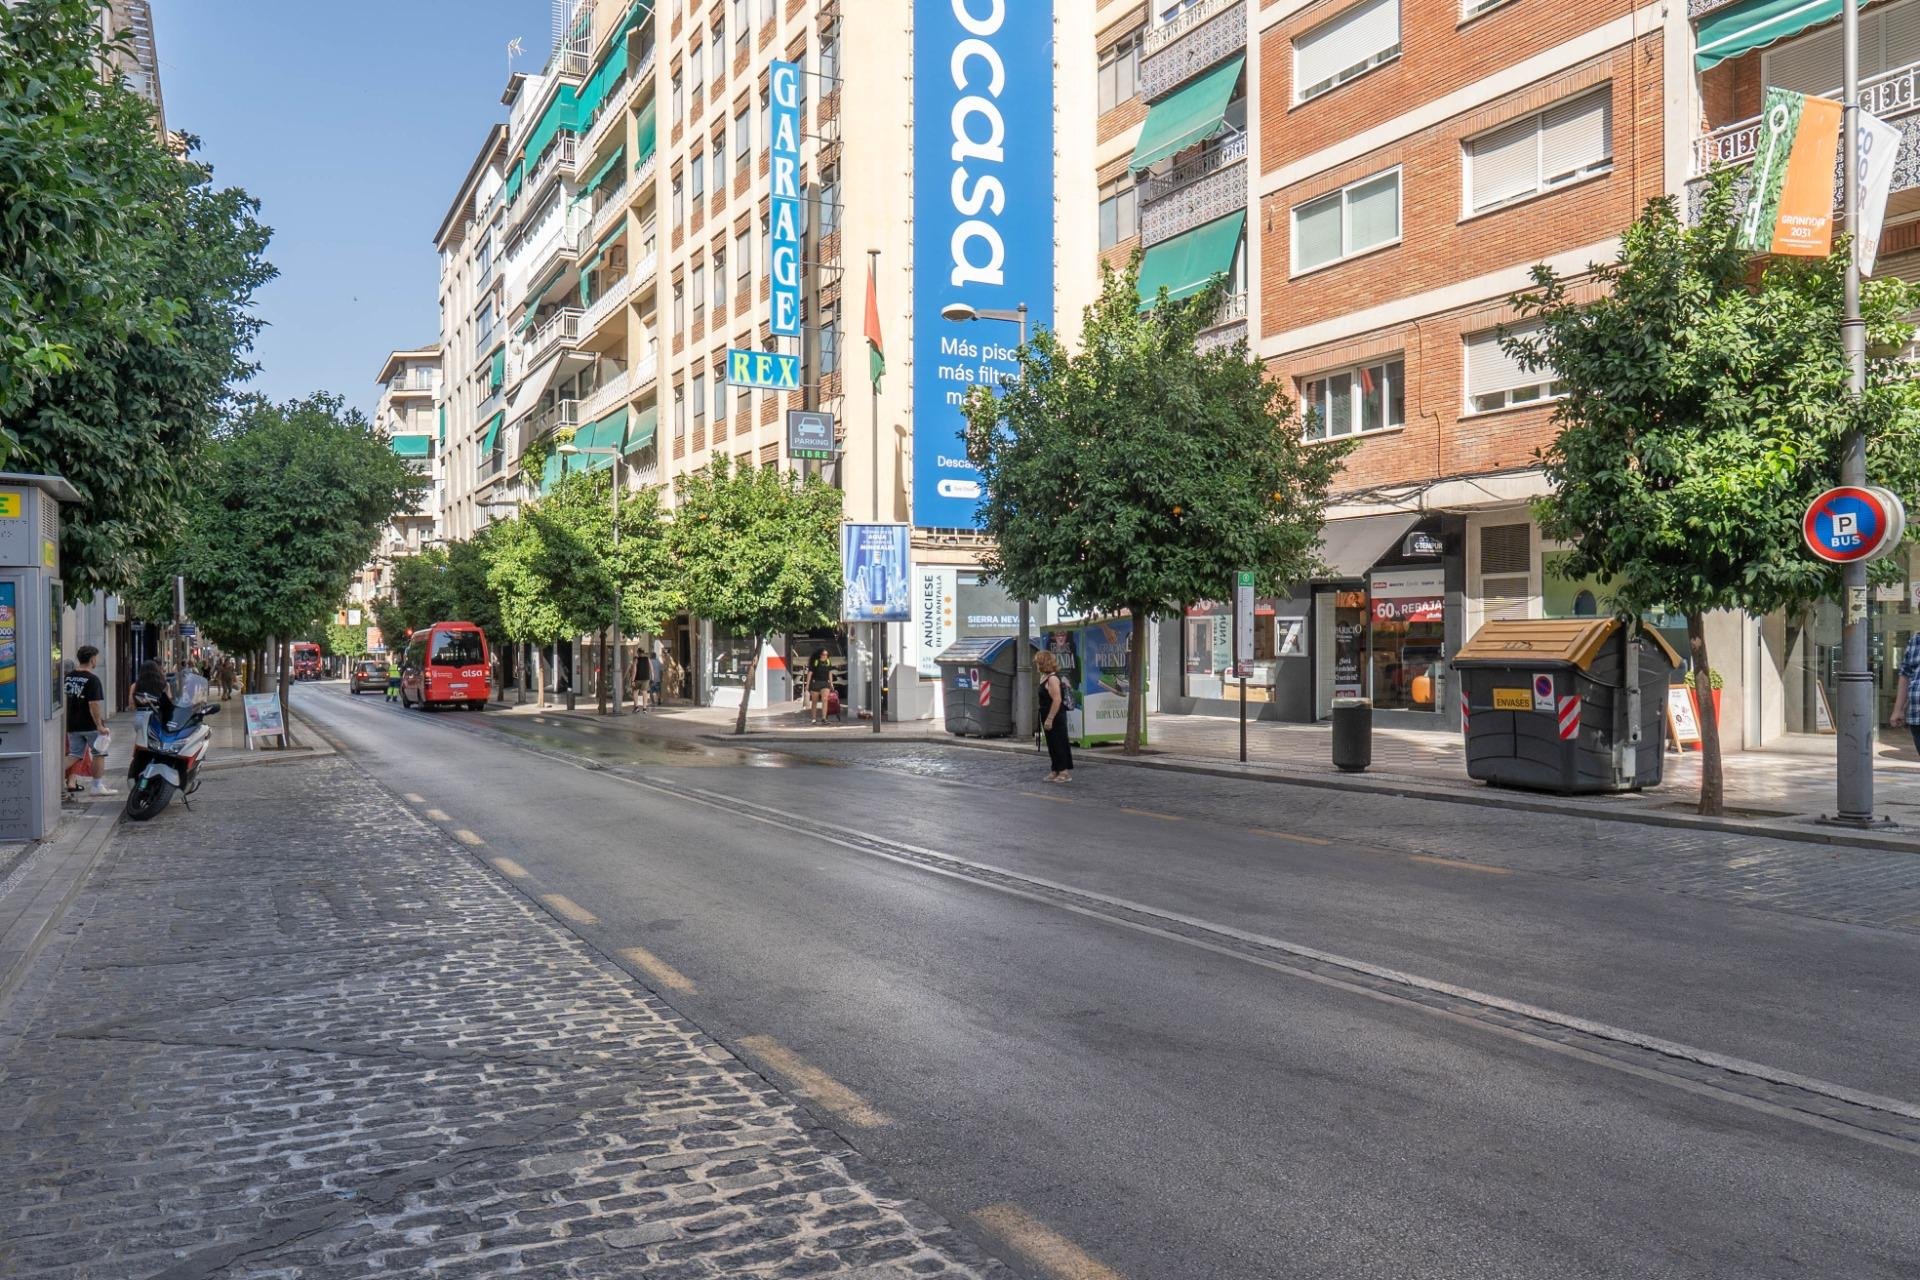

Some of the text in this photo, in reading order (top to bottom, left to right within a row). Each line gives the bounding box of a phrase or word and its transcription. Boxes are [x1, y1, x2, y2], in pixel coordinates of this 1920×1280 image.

[773, 66, 798, 333] GARAGE
[1791, 226, 1811, 238] 2031
[941, 336, 978, 357] Más
[733, 353, 796, 387] REX
[938, 363, 975, 382] más
[794, 437, 829, 446] PARKING
[794, 449, 829, 459] LIBRE
[1839, 516, 1852, 532] P
[1831, 535, 1861, 547] BUS
[922, 575, 933, 648] ANÚNCIESE
[1372, 602, 1401, 618] -60%
[967, 615, 1036, 624] SIERRA NEVA
[936, 637, 942, 648] EN
[1095, 653, 1127, 668] PREND
[461, 669, 483, 678] alsa
[1496, 698, 1530, 708] ENVASES
